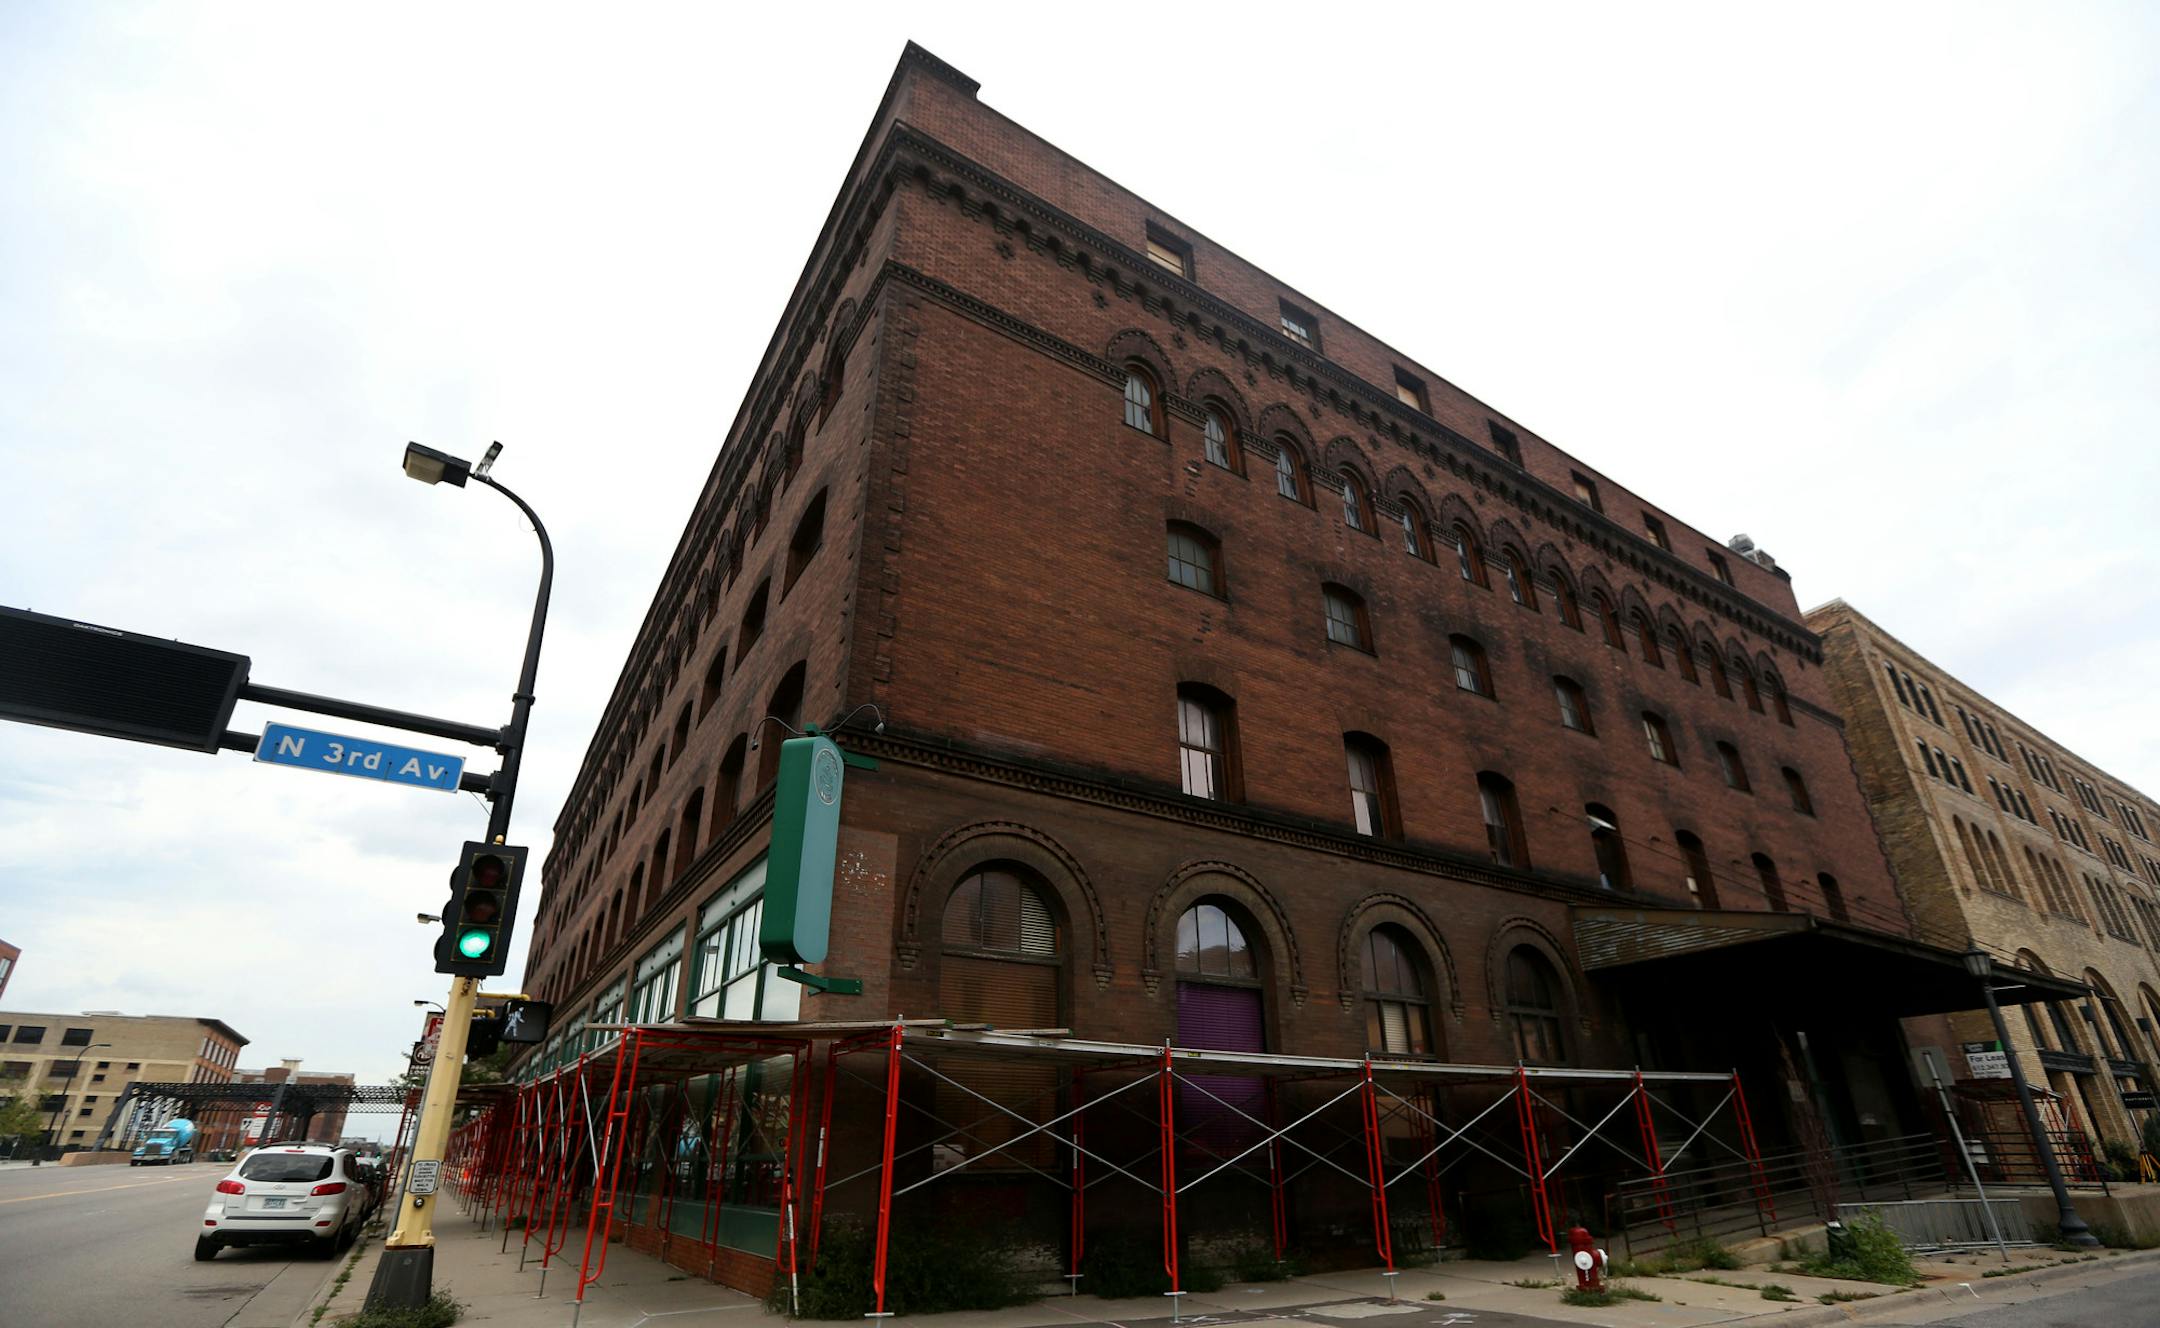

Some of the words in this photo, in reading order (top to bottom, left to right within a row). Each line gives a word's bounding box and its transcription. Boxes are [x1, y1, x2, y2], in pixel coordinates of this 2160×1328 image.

[277, 735, 305, 758] N
[322, 743, 383, 770] 3rd
[398, 757, 445, 780] Av
[1985, 1054, 2006, 1062] Leas
